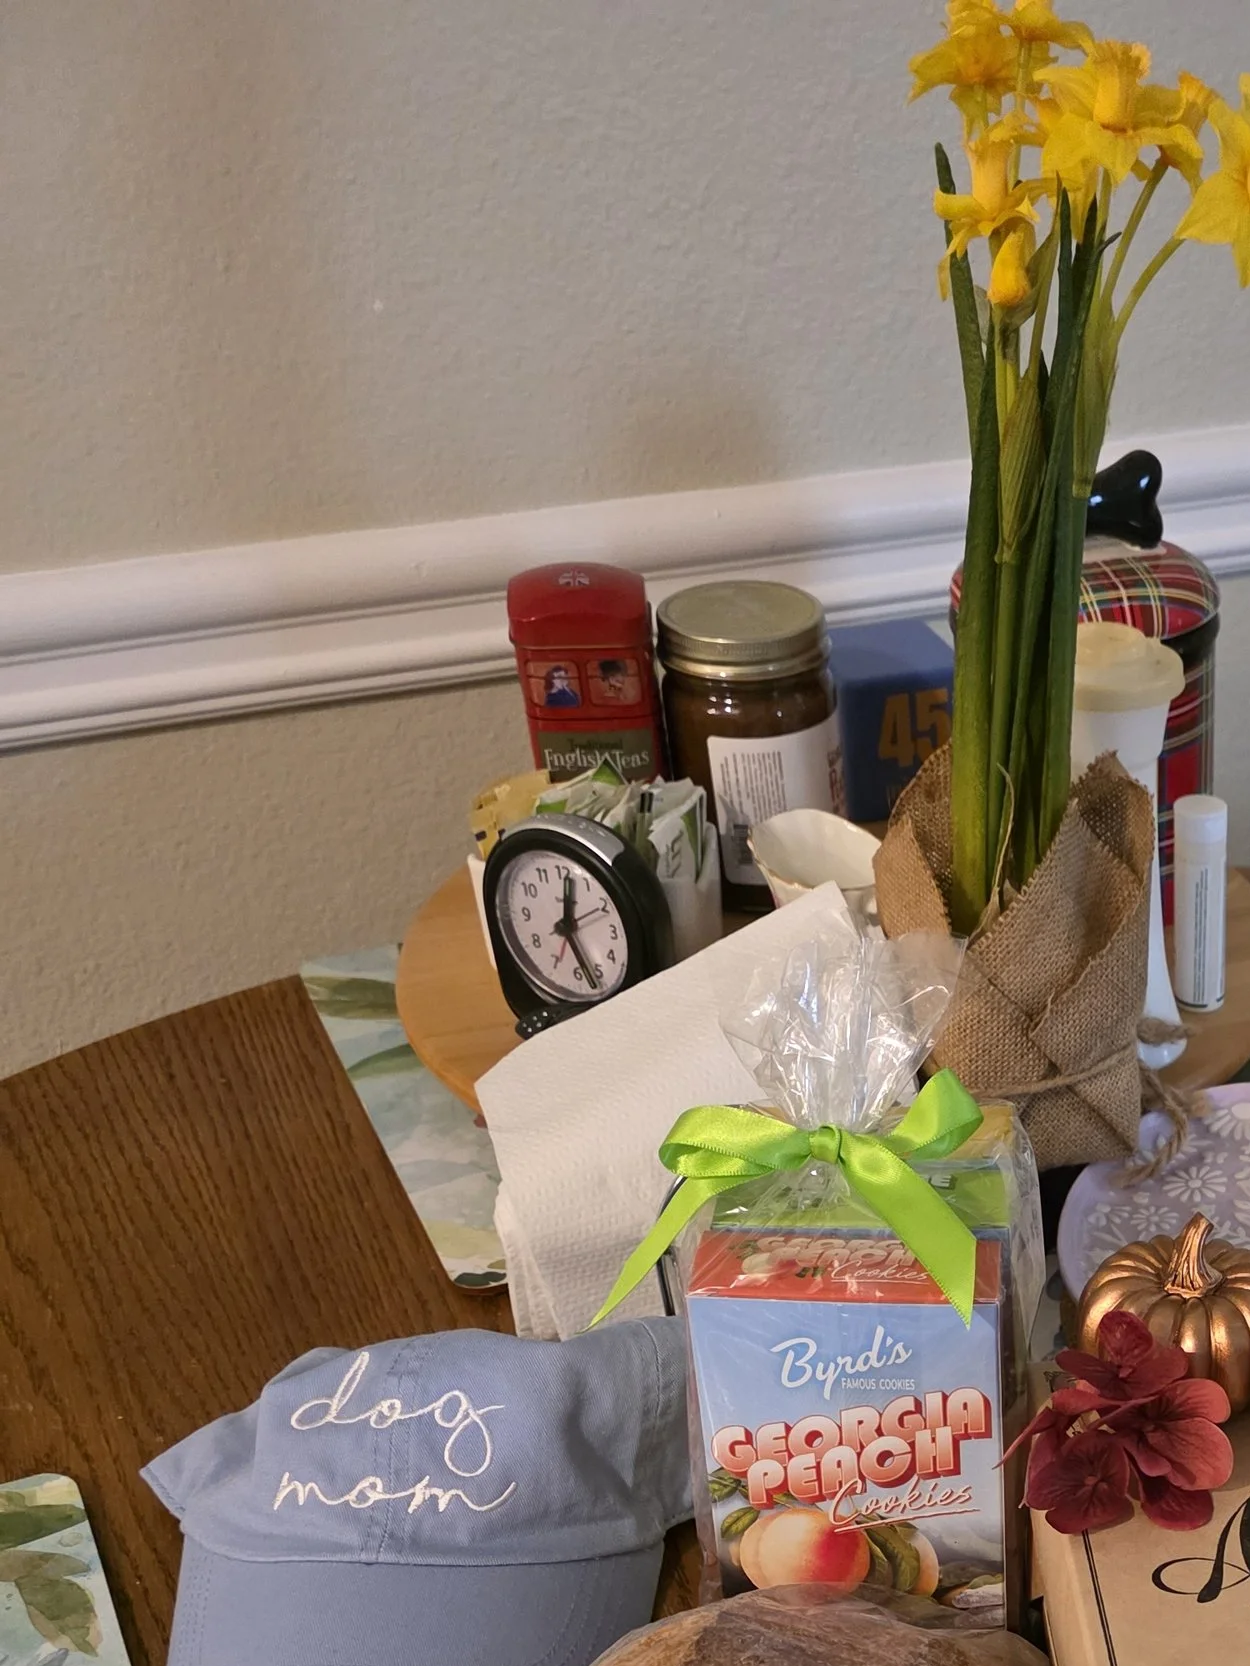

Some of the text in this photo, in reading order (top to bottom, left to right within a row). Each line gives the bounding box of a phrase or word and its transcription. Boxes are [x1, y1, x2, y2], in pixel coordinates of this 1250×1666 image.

[878, 687, 951, 767] 45
[536, 867, 550, 884] 11
[522, 882, 538, 899] 10
[522, 907, 532, 922] 9
[609, 924, 618, 940] 3
[532, 933, 542, 949] 8
[551, 954, 561, 969] 7
[607, 948, 616, 964] 4
[574, 966, 583, 981] 6
[770, 1325, 913, 1401] Byrd's
[841, 1377, 915, 1390] FAMOUS COOKIES
[290, 1351, 505, 1477] dog
[711, 1387, 992, 1478] GEORGIA
[747, 1426, 961, 1510] PEACH
[273, 1472, 516, 1513] mom
[828, 1478, 974, 1526] Cookies
